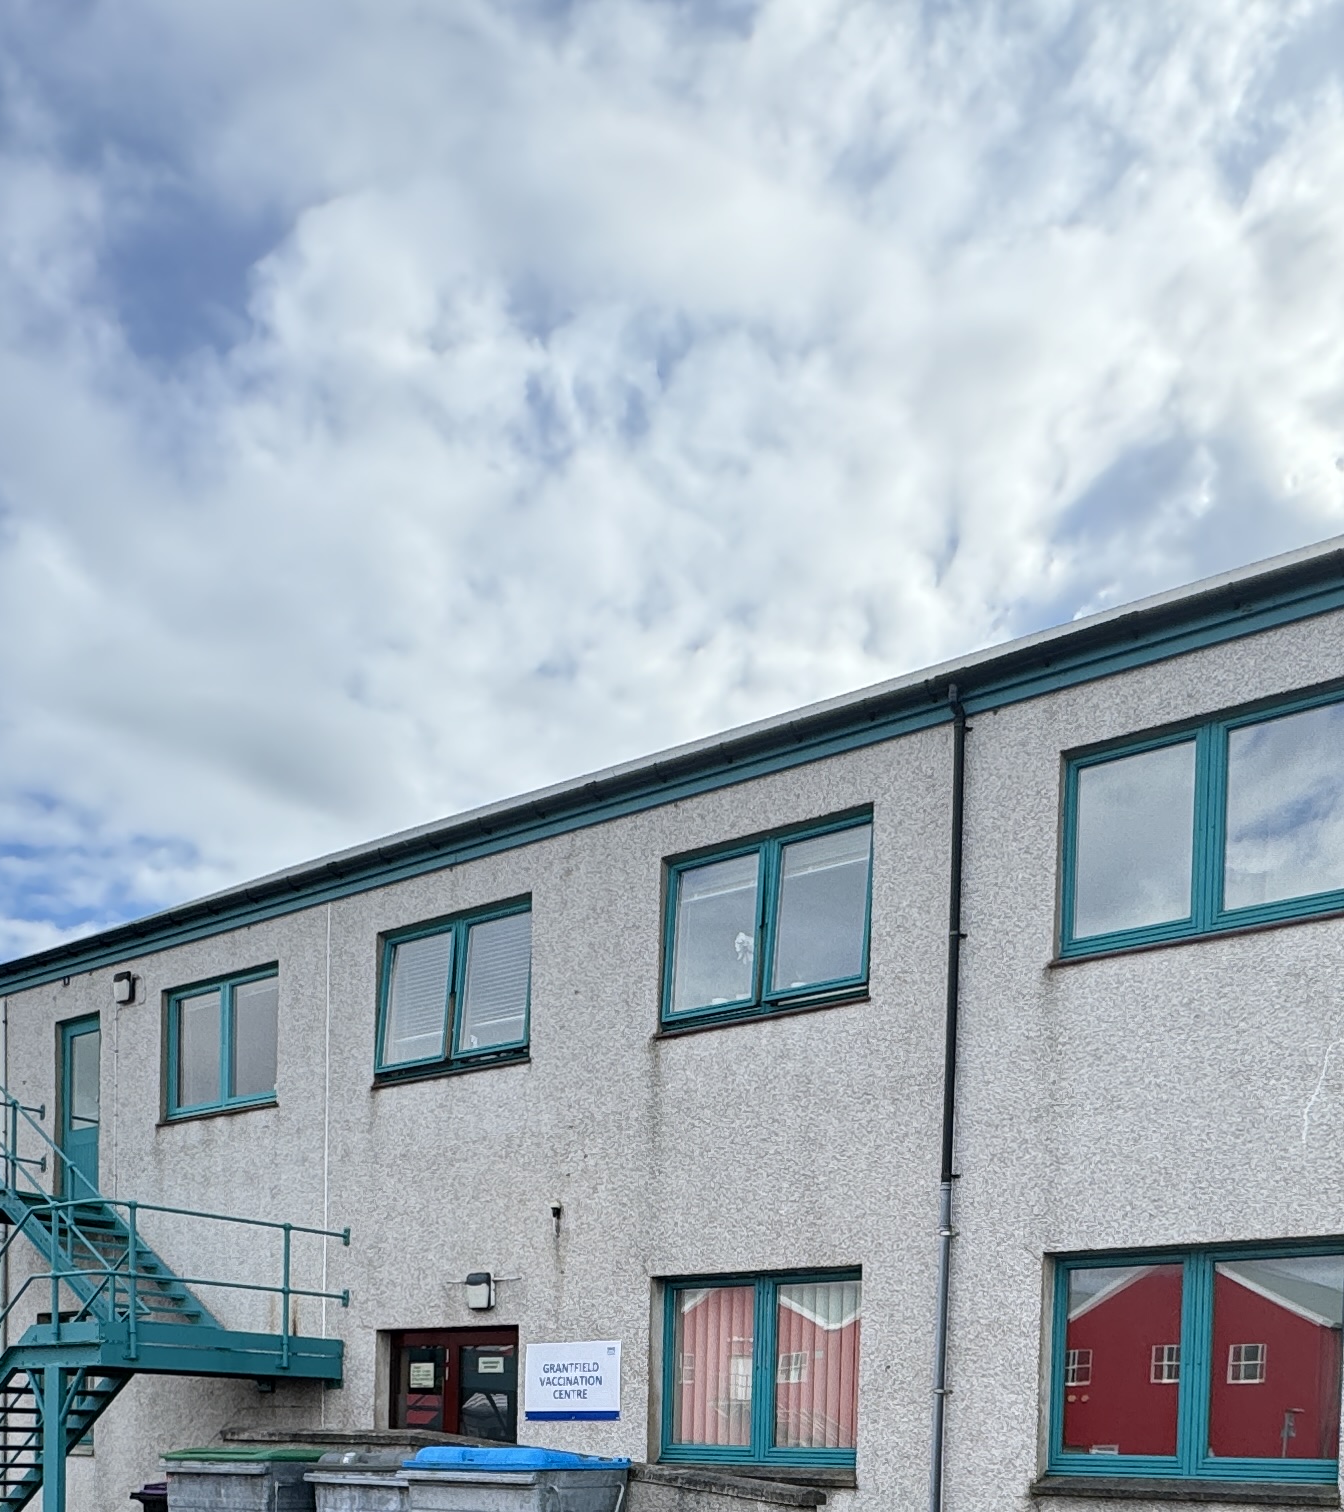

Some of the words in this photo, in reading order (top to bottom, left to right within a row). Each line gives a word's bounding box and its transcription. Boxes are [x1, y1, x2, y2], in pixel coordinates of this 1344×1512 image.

[542, 1362, 600, 1374] GRANTFIELD
[539, 1375, 603, 1387] VACCINATION
[552, 1389, 588, 1400] CENTRE
